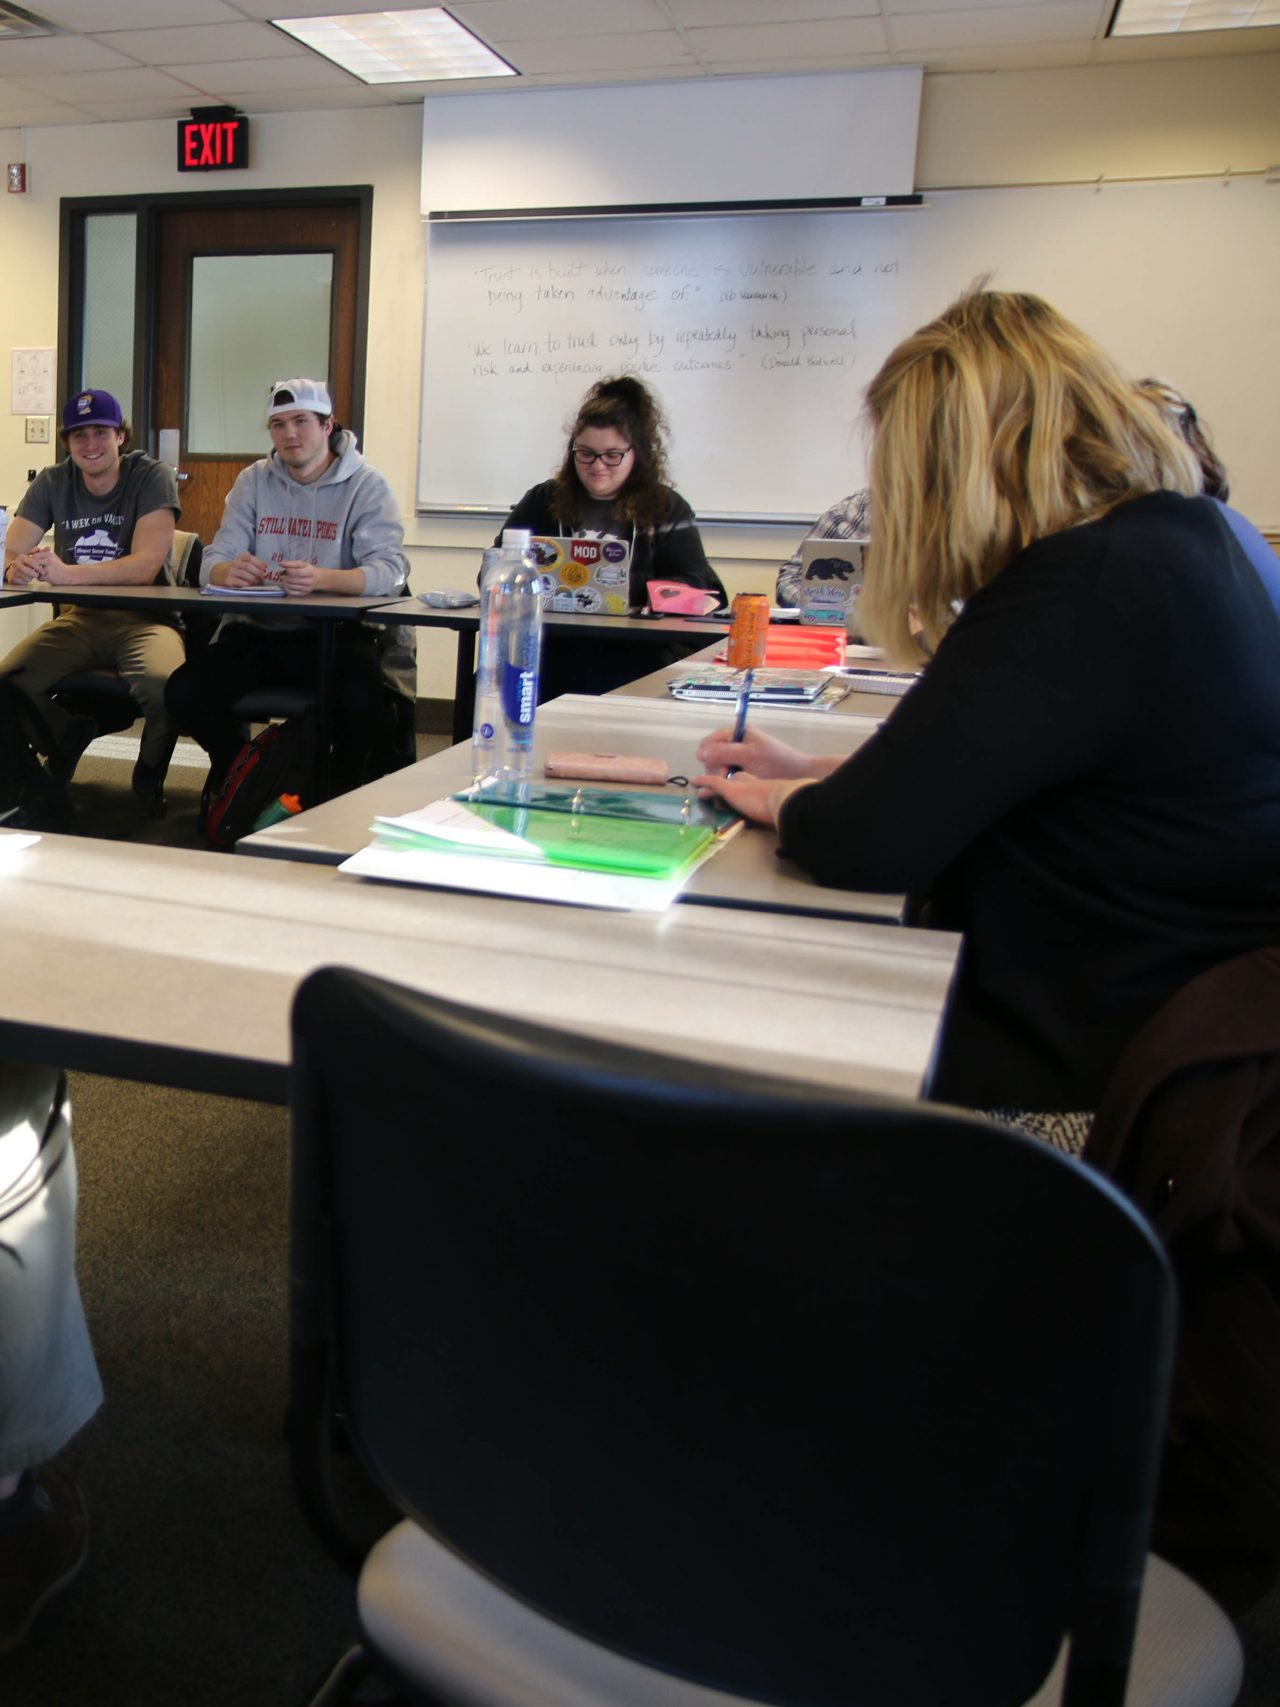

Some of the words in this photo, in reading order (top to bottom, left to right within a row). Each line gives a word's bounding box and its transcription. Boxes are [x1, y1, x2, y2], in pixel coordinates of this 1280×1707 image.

[184, 121, 239, 166] EXIT
[595, 260, 626, 277] when
[536, 284, 575, 301] taken
[586, 285, 659, 311] advantage
[503, 336, 539, 356] learn
[545, 330, 561, 354] to
[567, 329, 599, 350] trust
[609, 333, 640, 358] only
[648, 329, 665, 358] by
[676, 326, 737, 352] repeatedly
[750, 322, 791, 353] taking
[802, 319, 858, 346] personal
[473, 360, 499, 376] risk
[509, 361, 535, 374] and
[573, 545, 597, 559] MOD
[519, 670, 534, 723] smart
